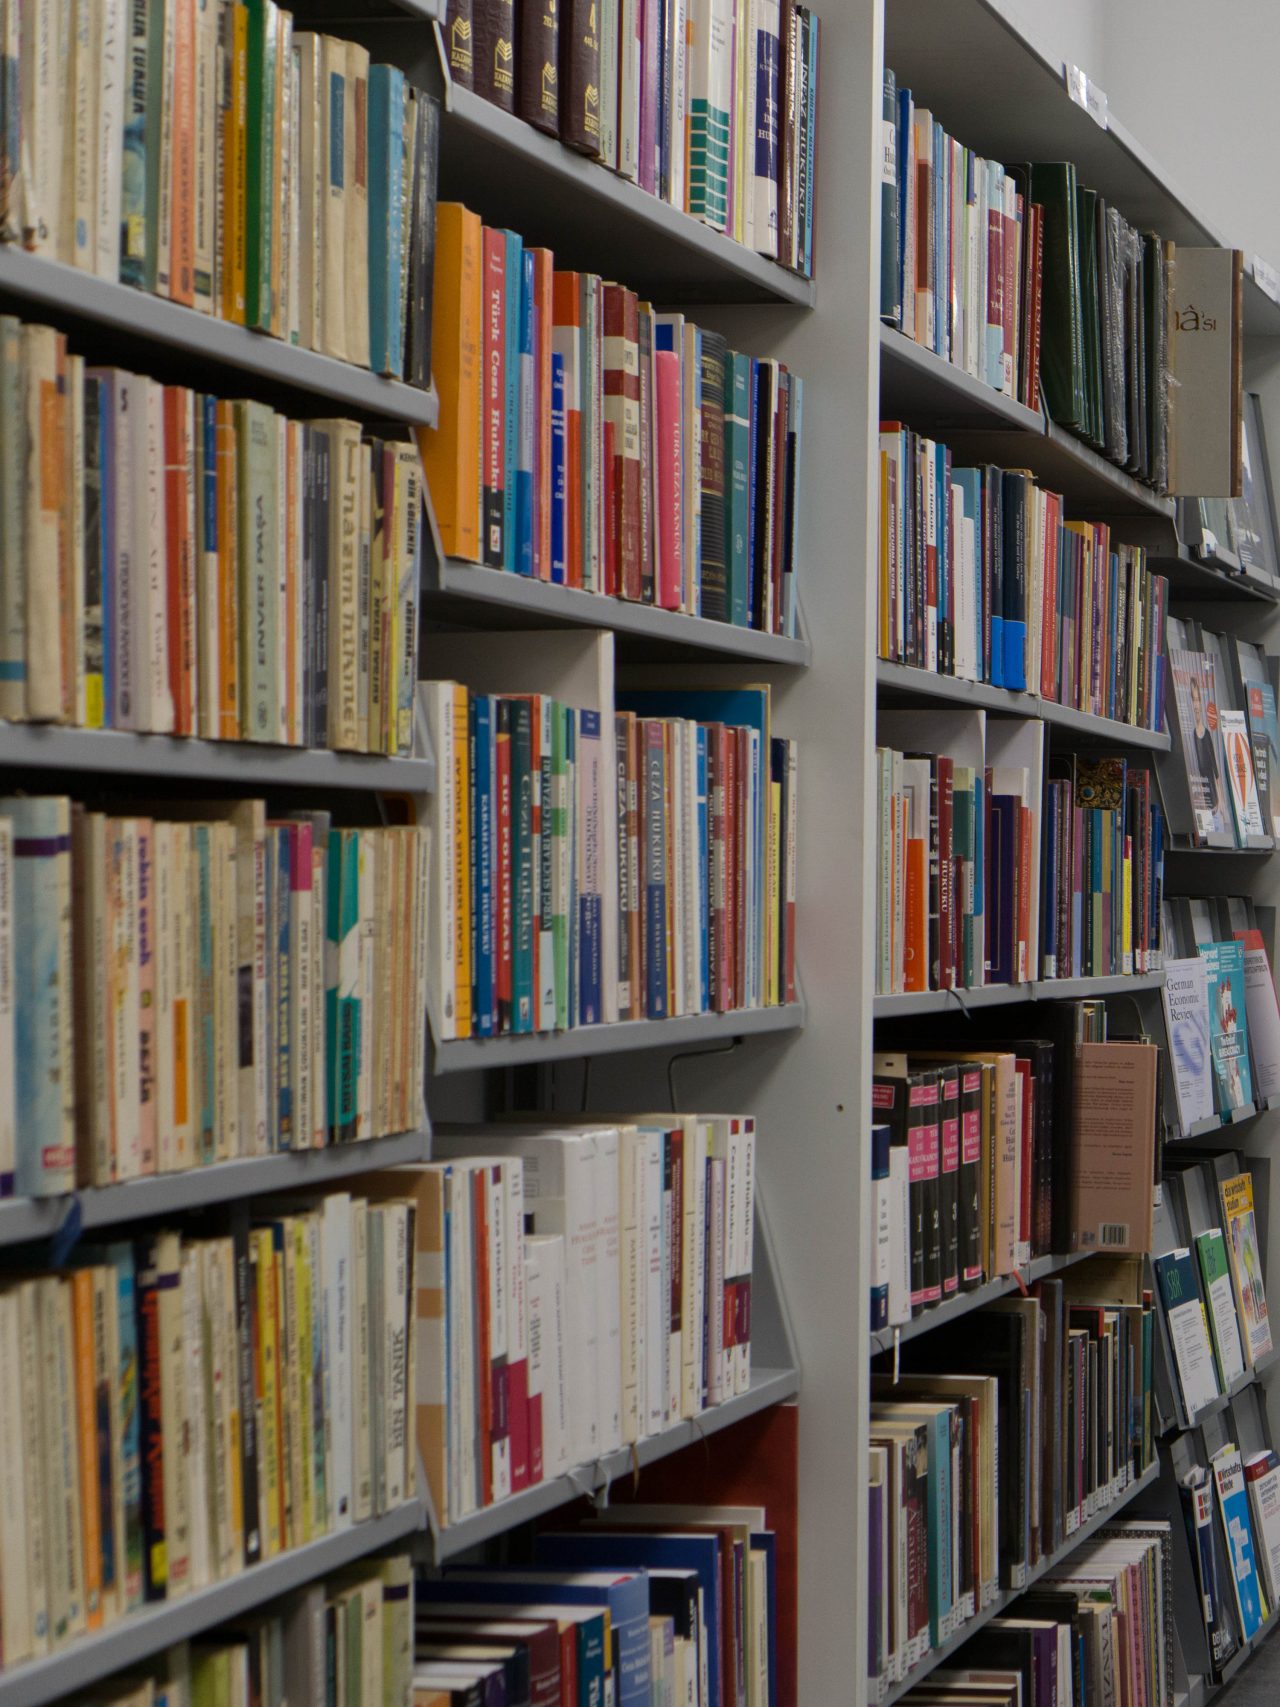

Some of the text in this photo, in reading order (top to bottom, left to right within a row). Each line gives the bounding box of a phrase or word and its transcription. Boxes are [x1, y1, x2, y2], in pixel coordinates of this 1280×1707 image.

[799, 127, 807, 217] HUKUKU
[490, 289, 500, 493] Türk Ceza Hukuku
[673, 461, 681, 498] CEZA
[673, 502, 681, 560] KANUNU
[255, 495, 266, 666] ENVER PAŞA
[651, 760, 661, 801] CEZA
[139, 837, 152, 900] robin
[501, 774, 510, 960] SUÇ POLİTİKASI
[521, 774, 532, 950] Ceza Hukuku
[618, 762, 627, 911] CEZA HUKUKU
[651, 810, 662, 882] HUKUKU
[481, 794, 490, 954] KABAHATLER HUKUKU
[941, 859, 949, 913] HUKUKU
[1167, 978, 1194, 992] German
[1169, 991, 1200, 1007] Economic
[1170, 1006, 1194, 1023] Review
[729, 1183, 737, 1240] Hukuku
[1167, 1268, 1183, 1301] SBR
[391, 1327, 404, 1450] BİN TANIK
[908, 1508, 919, 1600] Atatürk
